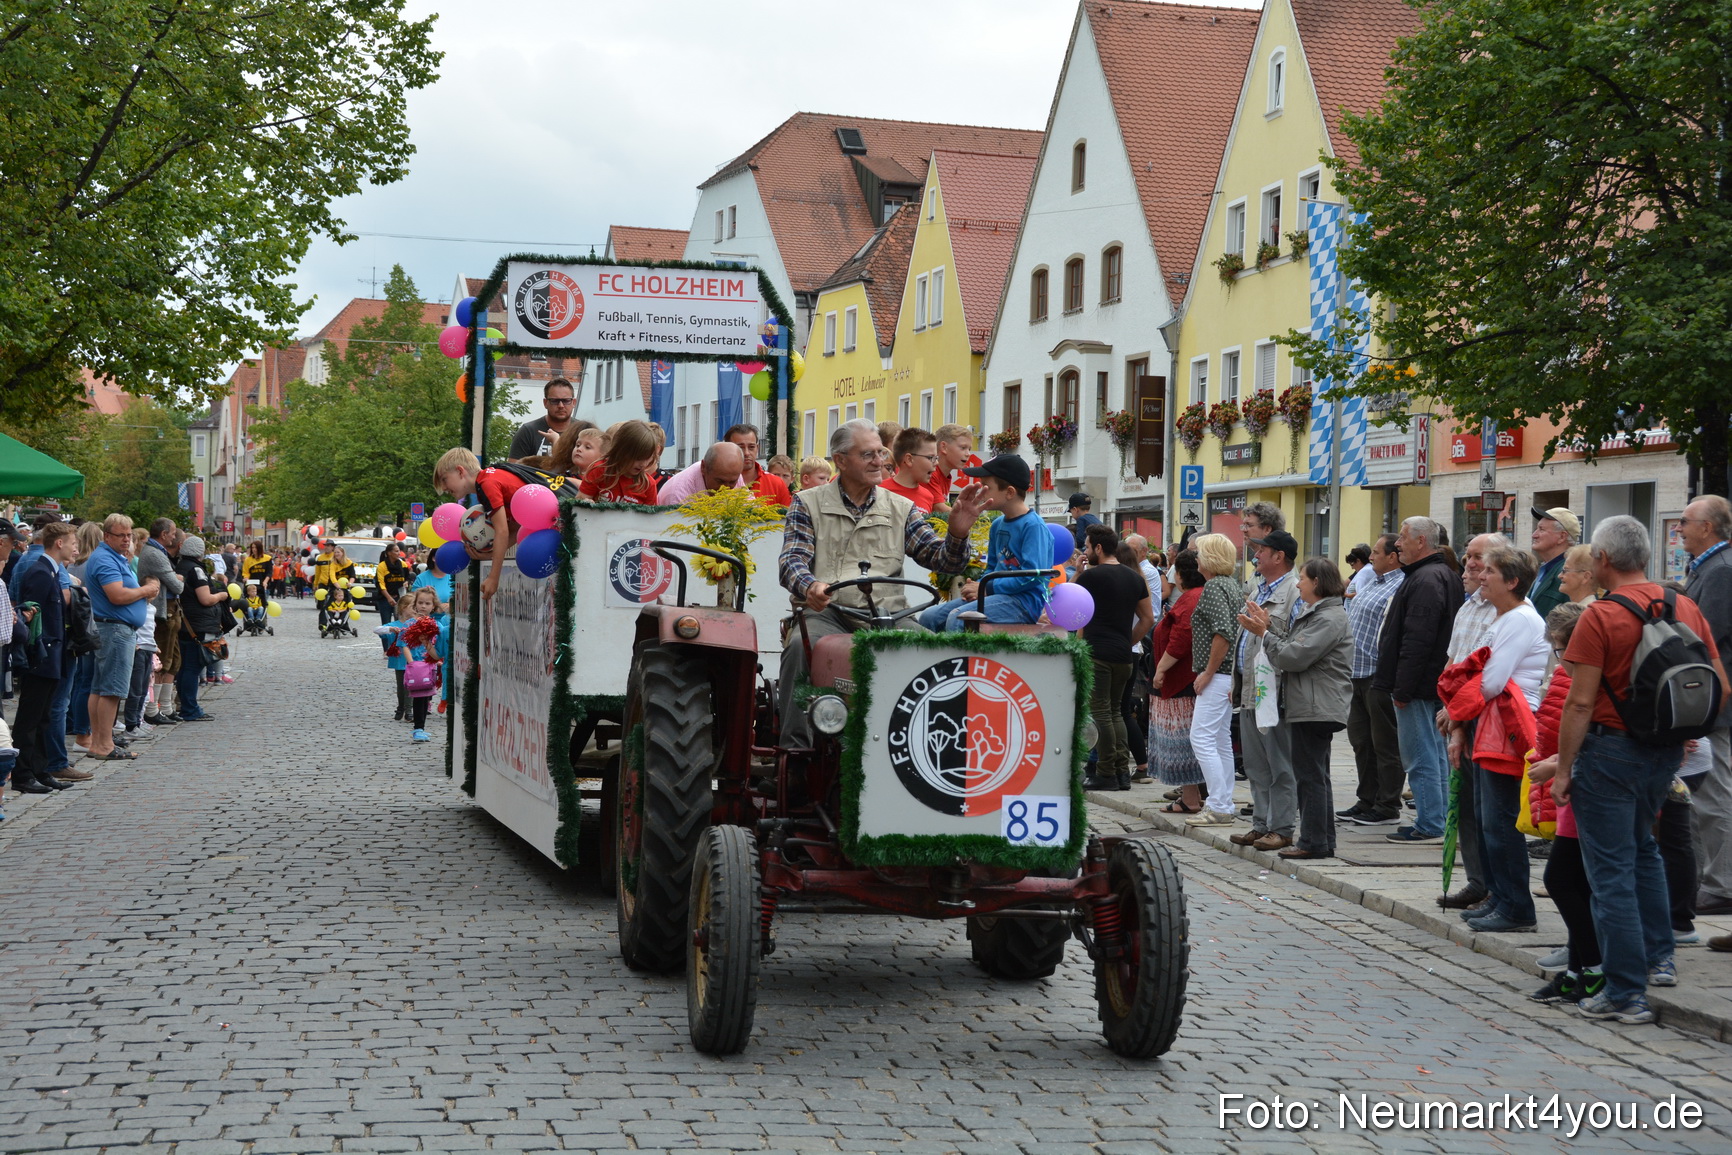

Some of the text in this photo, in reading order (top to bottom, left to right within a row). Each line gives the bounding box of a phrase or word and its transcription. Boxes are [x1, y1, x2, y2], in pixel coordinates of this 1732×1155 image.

[519, 271, 581, 296] HOLZHEIM
[598, 273, 744, 297] FC HOLZHEIM
[598, 312, 751, 329] Fußball, Tennis, Gymnastik,
[598, 331, 627, 342] Kraft
[638, 332, 682, 344] Fitness,
[685, 334, 746, 346] Kindertanz
[834, 373, 886, 399] HOTEL Lehmeier
[1223, 449, 1238, 460] WOLLE
[1242, 447, 1253, 458] MEH
[1370, 443, 1406, 459] RIALTO KINO
[1417, 418, 1427, 480] KINO
[1185, 469, 1199, 496] P
[1211, 498, 1228, 510] WOLLE
[1232, 496, 1246, 509] MEHR
[613, 540, 667, 562] HOLZH
[897, 658, 1038, 714] HOLZHEIM
[889, 726, 910, 766] F.C.
[1006, 800, 1060, 841] 85
